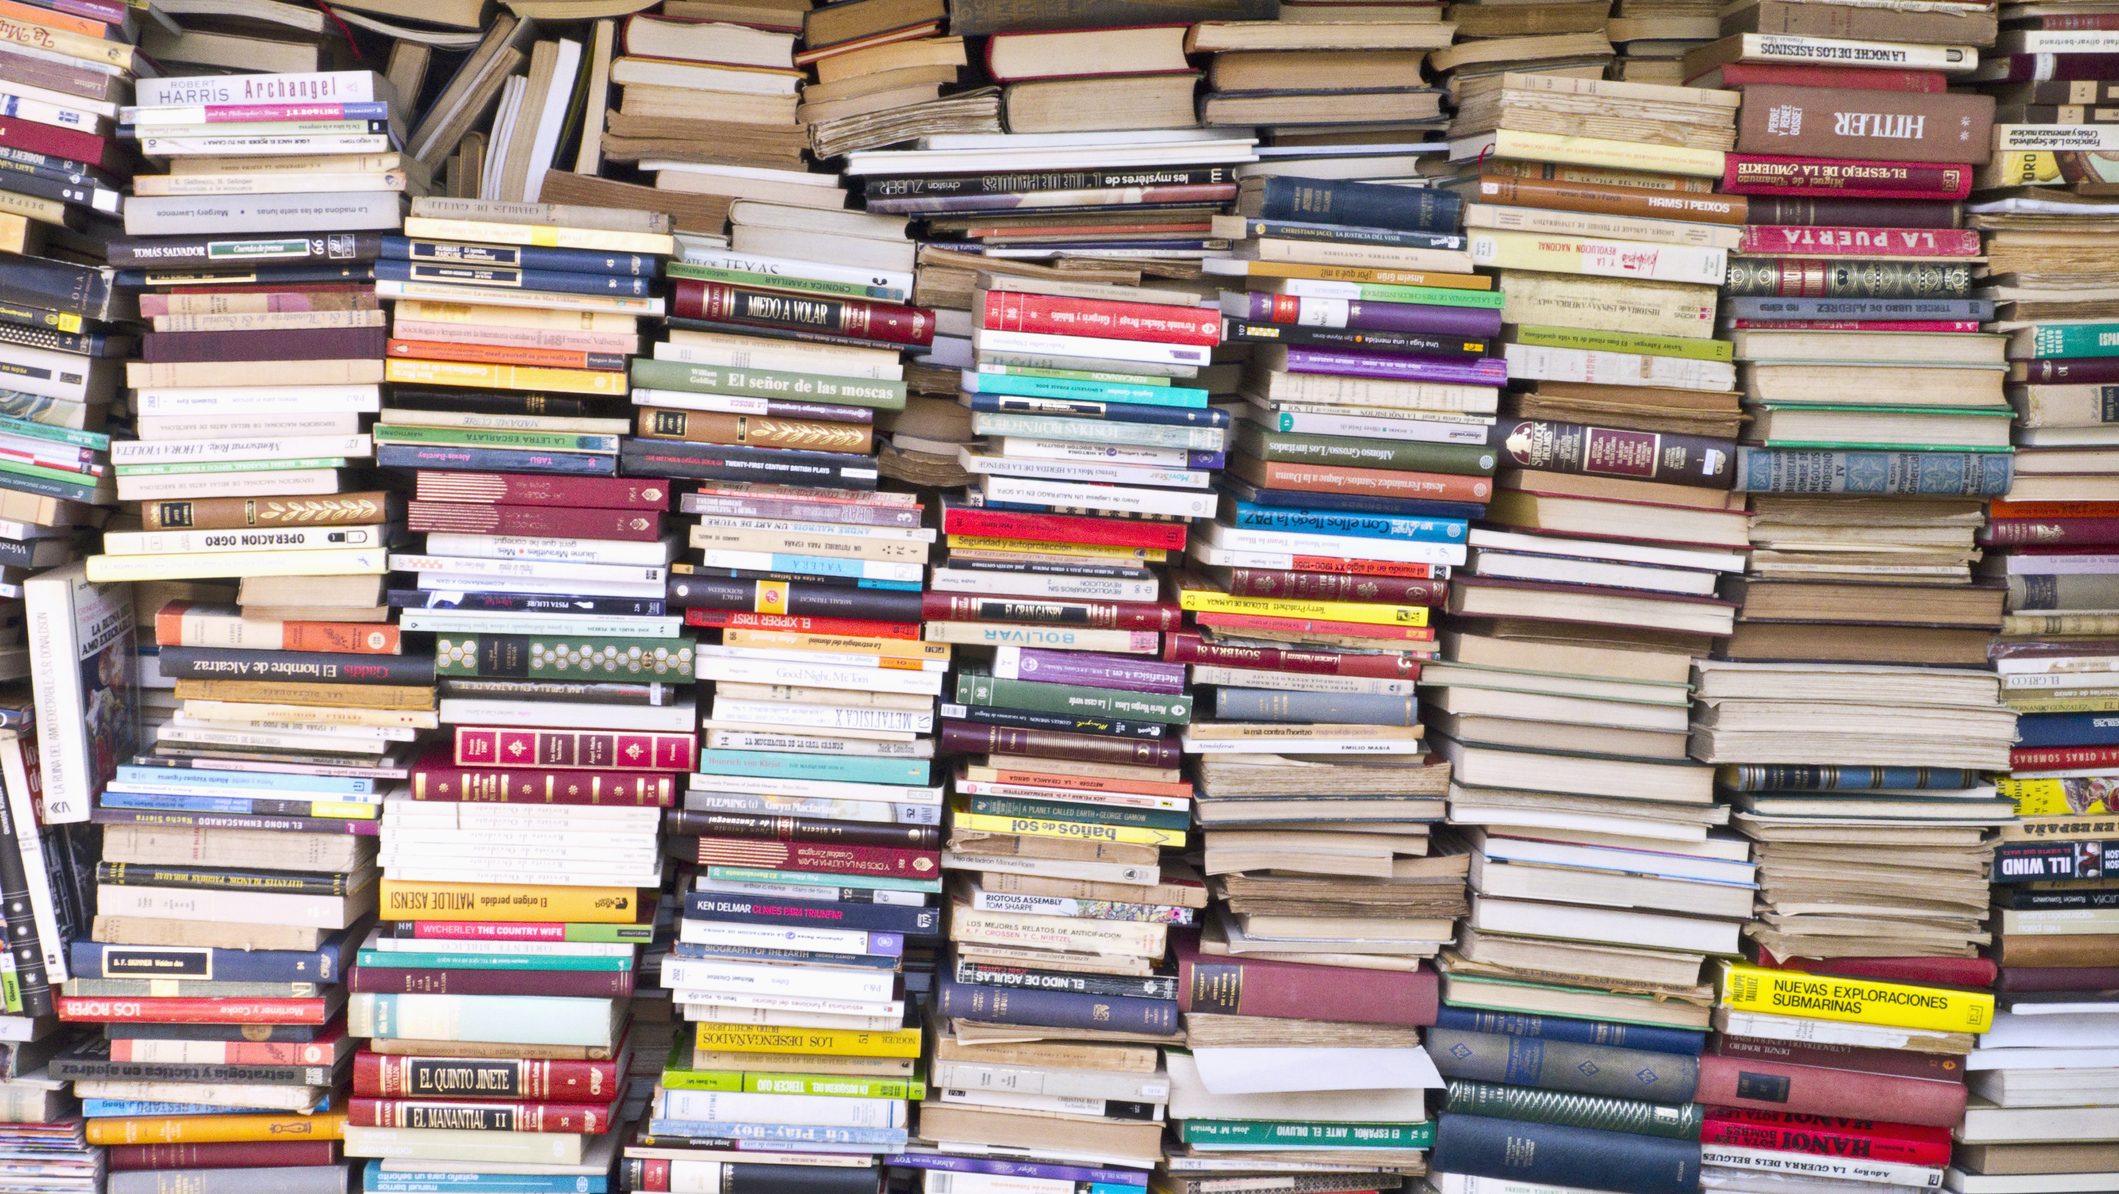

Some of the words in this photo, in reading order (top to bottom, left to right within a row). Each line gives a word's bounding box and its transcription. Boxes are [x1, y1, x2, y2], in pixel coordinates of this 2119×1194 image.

[1761, 43, 1814, 56] ASESINOS
[1817, 47, 1838, 57] LOS
[1839, 47, 1852, 58] DE
[1855, 49, 1891, 60] NOCHE
[1892, 50, 1906, 60] LA
[160, 89, 229, 104] HARRIS
[245, 77, 336, 99] Archangel
[1834, 111, 1925, 138] HITLER
[1738, 163, 1798, 176] MUERTE
[1803, 165, 1819, 176] LA
[1822, 166, 1839, 177] DE
[1891, 167, 1907, 179] EL
[2022, 153, 2036, 181] ORO
[1042, 174, 1058, 189] DE
[1106, 176, 1120, 185] de
[1123, 173, 1171, 186] mystères
[1173, 174, 1188, 184] les
[1791, 177, 1804, 186] de
[1809, 176, 1844, 187] Miguel
[880, 180, 924, 193] ZUBER
[928, 181, 960, 191] christian
[196, 207, 228, 216] Margery
[257, 208, 277, 216] lunas
[325, 207, 357, 215] madona
[1783, 230, 1887, 247] PUERTA
[1901, 232, 1934, 247] LA
[163, 245, 205, 258] SALVADOR
[747, 296, 780, 317] MIEDO
[782, 299, 791, 319] A
[795, 301, 827, 325] VOLAR
[728, 373, 744, 386] El
[748, 373, 789, 391] señor
[795, 377, 812, 393] de
[817, 379, 836, 394] las
[842, 382, 894, 400] moscas
[466, 433, 520, 442] ESCARLATA
[524, 435, 552, 444] LETRA
[1270, 441, 1307, 455] invitados
[1361, 449, 1395, 460] Alfonso
[1275, 471, 1302, 483] Dama
[1304, 474, 1312, 483] la
[1379, 477, 1420, 491] Fernández
[1422, 482, 1445, 493] Jesús
[1246, 515, 1272, 527] PAZ
[1277, 515, 1287, 526] la
[1291, 511, 1324, 529] llegó
[1328, 518, 1358, 533] ellos
[1362, 520, 1390, 533] Con
[206, 535, 236, 547] OGRO
[241, 533, 304, 547] OPERACION
[959, 535, 1001, 549] Seguridad
[732, 613, 758, 626] TRIST
[761, 614, 797, 628] XIPRER
[800, 617, 811, 629] EL
[983, 629, 1075, 646] BOLÍVAR
[193, 660, 250, 675] Alcatraz
[253, 662, 268, 675] de
[272, 662, 320, 677] hombre
[323, 664, 337, 677] El
[344, 665, 389, 679] Gaddis
[2014, 753, 2060, 763] SOMBRAS
[2065, 753, 2095, 762] OTRAS
[135, 814, 164, 824] Sierra
[167, 816, 192, 825] Nacho
[198, 817, 260, 827] ENMASCARADO
[263, 820, 288, 828] MONO
[290, 821, 302, 829] EL
[1012, 820, 1038, 832] sol
[1042, 823, 1055, 832] de
[1059, 823, 1115, 841] baños
[2024, 823, 2090, 835] ESPAÑA
[2094, 823, 2114, 833] EN
[2002, 858, 2044, 875] WIND
[2049, 856, 2070, 872] ILL
[391, 893, 426, 909] ASENSI
[432, 893, 475, 909] MATILDE
[481, 894, 511, 907] perdido
[513, 894, 538, 906] origen
[540, 897, 548, 907] El
[986, 894, 1021, 903] RIOTOUS
[1022, 896, 1062, 906] ASSEMBLY
[697, 900, 714, 913] KEN
[716, 902, 751, 914] DELMAR
[1004, 903, 1033, 911] SHARPE
[423, 925, 476, 935] WYCHERLEY
[478, 925, 493, 935] THE
[497, 925, 538, 936] COUNTRY
[540, 926, 562, 936] WIFE
[1026, 975, 1040, 986] DE
[1042, 977, 1069, 988] NIDO
[1072, 979, 1084, 989] EL
[1774, 980, 1827, 996] NUEVAS
[1833, 986, 1948, 1009] EXPLORACIONES
[67, 1002, 109, 1016] ROPER
[113, 1003, 139, 1016] LOS
[253, 1006, 260, 1014] y
[1772, 994, 1862, 1014] SUBMARINAS
[221, 1006, 250, 1015] Cooke
[262, 1007, 304, 1016] Mortimer
[810, 1035, 833, 1047] LOS
[61, 1063, 120, 1078] ajedrez
[123, 1066, 139, 1075] en
[143, 1066, 199, 1081] táctica
[202, 1066, 211, 1078] y
[214, 1066, 295, 1081] estrategia
[419, 1070, 430, 1089] EL
[434, 1070, 473, 1090] QUINTO
[476, 1070, 509, 1091] JINETE
[414, 1108, 425, 1128] EL
[427, 1108, 487, 1129] MANANTIAL
[496, 1112, 506, 1129] II
[1782, 1131, 1871, 1157] HANOI
[1703, 1153, 1751, 1165] BELGUES
[1754, 1158, 1781, 1168] DELS
[1785, 1162, 1831, 1173] GUERRA
